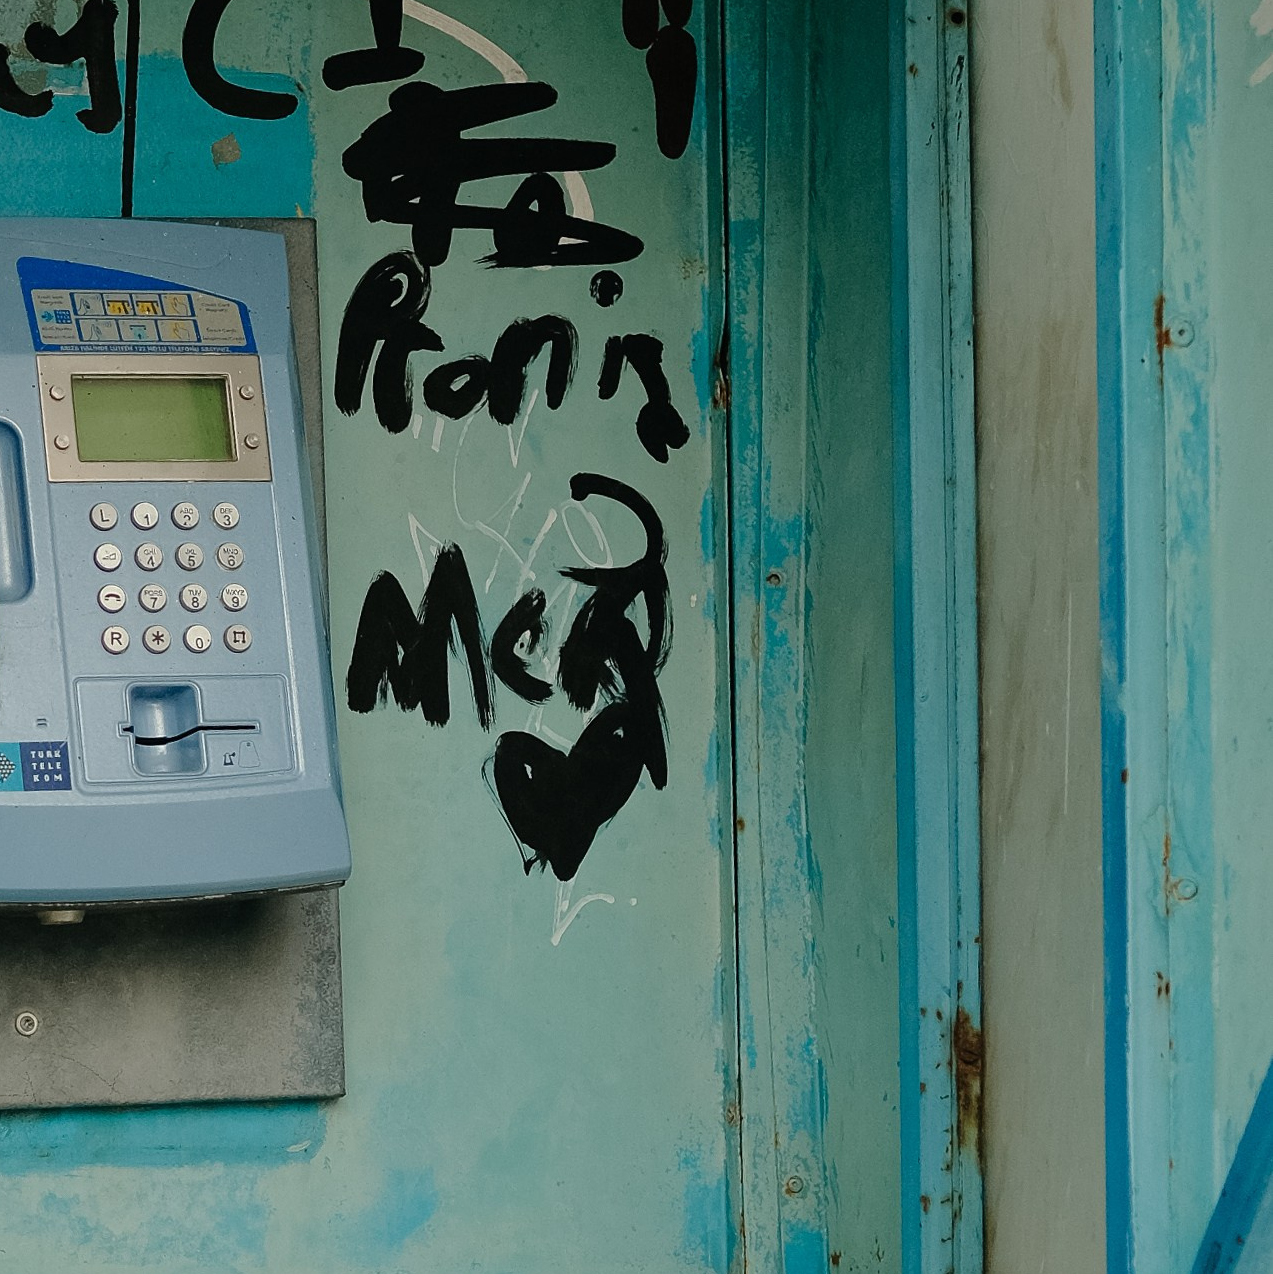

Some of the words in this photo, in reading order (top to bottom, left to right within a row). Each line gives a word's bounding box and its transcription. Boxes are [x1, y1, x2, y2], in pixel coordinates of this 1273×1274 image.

[100, 509, 110, 522] L
[143, 514, 150, 526] 1
[223, 514, 232, 526] 3
[187, 555, 196, 567] 5
[227, 555, 236, 567] 6
[150, 596, 158, 608] 7
[191, 596, 200, 608] 8
[231, 596, 240, 608] 9
[110, 631, 122, 646] R
[195, 637, 204, 649] 0
[31, 761, 62, 770] TELE
[33, 773, 63, 783] KOM
